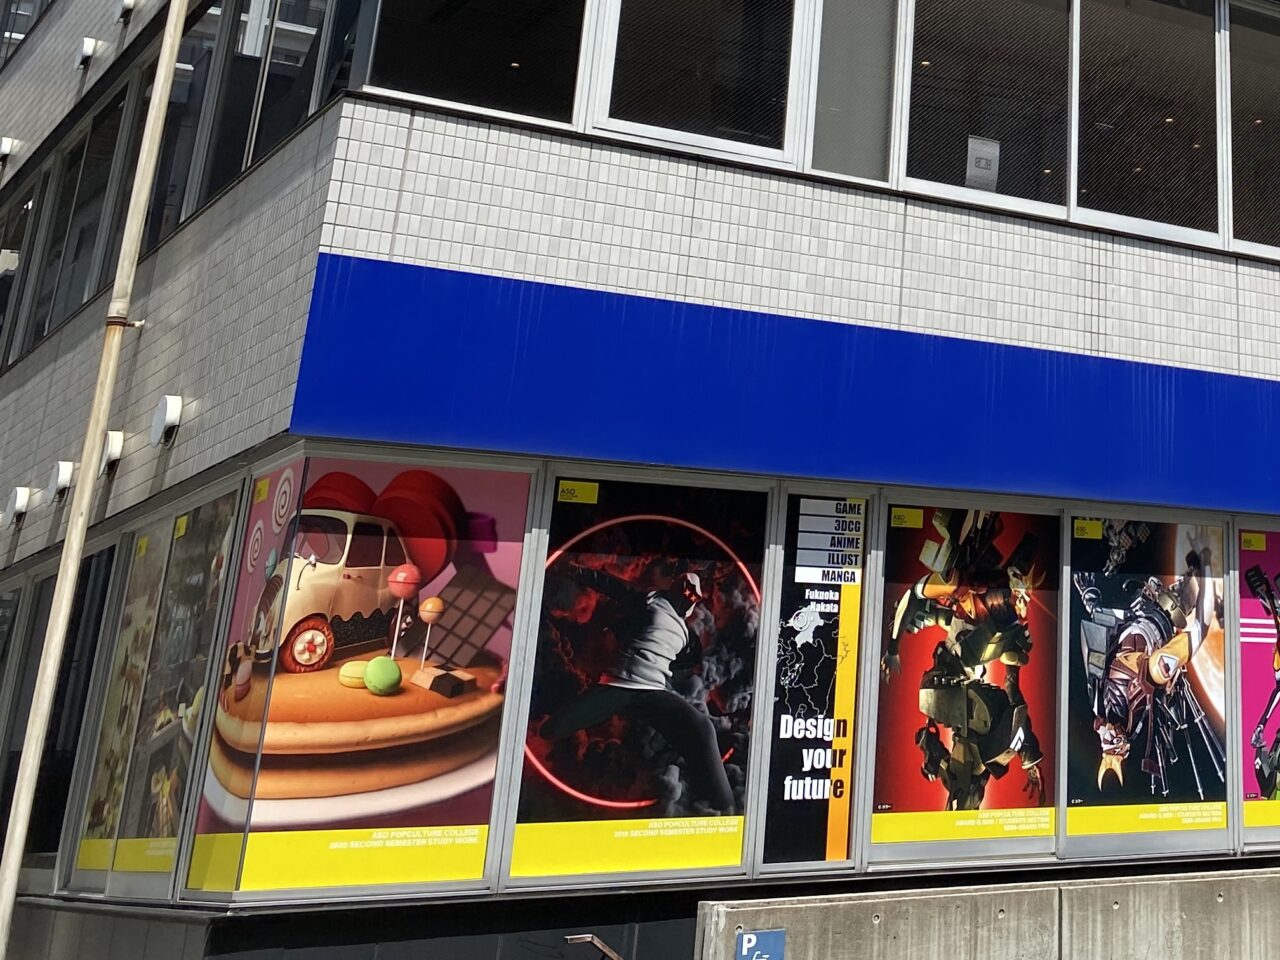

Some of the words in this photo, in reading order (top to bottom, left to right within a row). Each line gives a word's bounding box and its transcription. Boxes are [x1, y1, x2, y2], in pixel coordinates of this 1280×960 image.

[835, 502, 862, 515] GAME
[834, 519, 861, 532] 3DCG
[829, 536, 860, 549] ANIME
[827, 553, 860, 566] ILLUST
[821, 570, 856, 583] MANGA
[804, 588, 840, 601] Fukuoka
[809, 601, 839, 613] Hakata
[779, 714, 847, 742] Design
[802, 748, 847, 772] your
[783, 775, 844, 801] future
[741, 933, 757, 956] P
